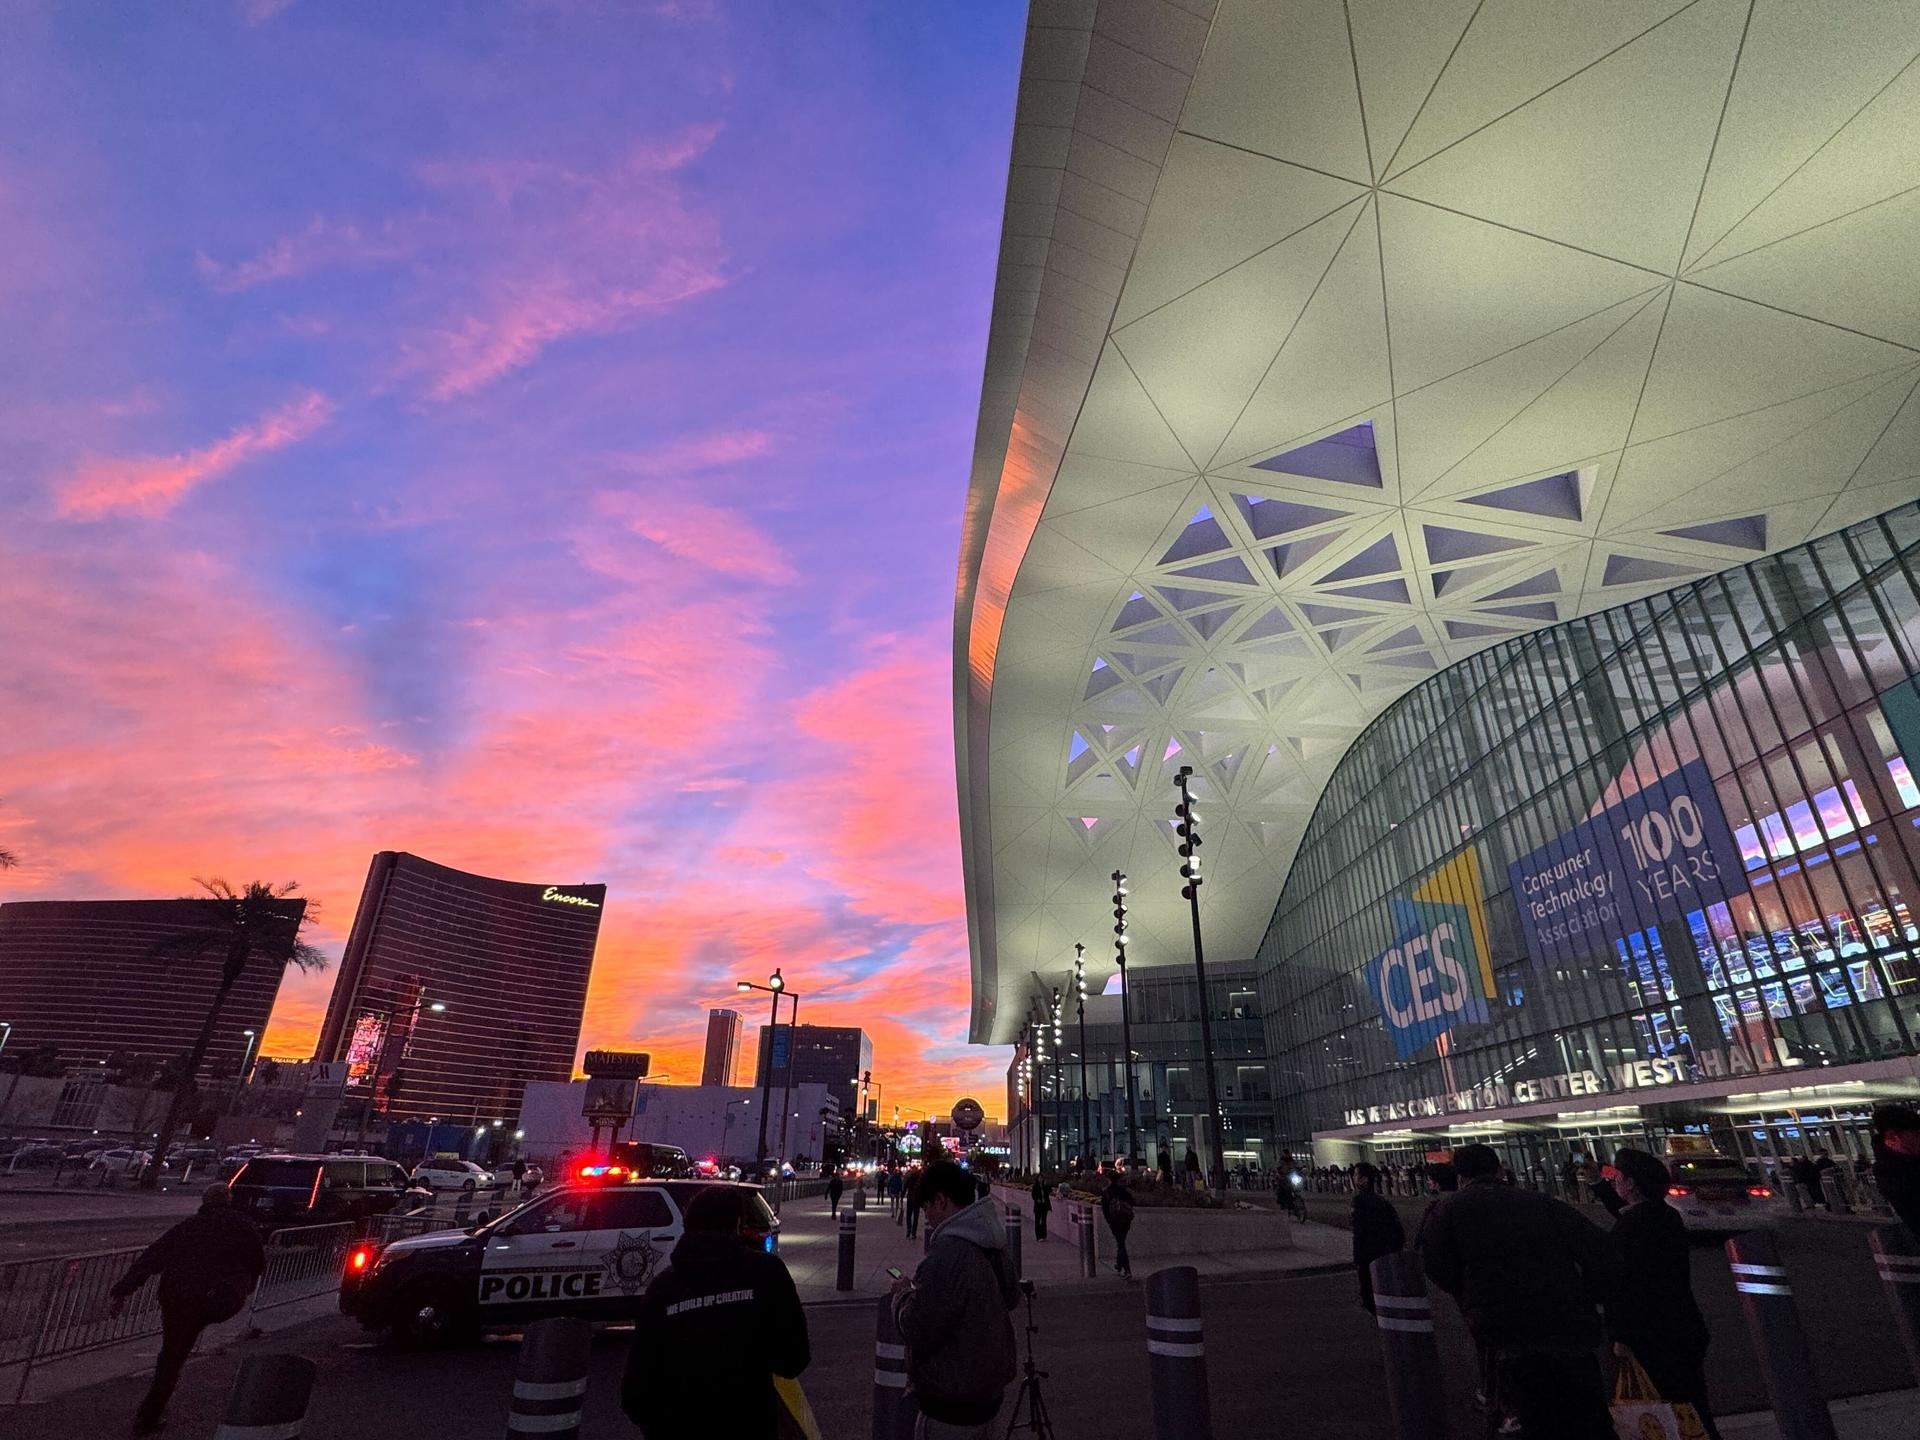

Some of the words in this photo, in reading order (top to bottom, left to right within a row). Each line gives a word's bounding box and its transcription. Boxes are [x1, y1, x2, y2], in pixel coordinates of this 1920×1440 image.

[1621, 795, 1704, 871] 100
[1522, 849, 1591, 894] Consumer
[1528, 871, 1613, 921] Technology
[1637, 850, 1721, 904] YEARS
[542, 886, 599, 908] Encore
[1380, 922, 1468, 1029] CES
[1344, 1109, 1366, 1126] LAS
[1366, 1102, 1407, 1123] VEGAS
[1408, 1084, 1512, 1117] CONVENTION
[1514, 1069, 1600, 1103] CENTER
[1607, 1054, 1688, 1091] WEST
[1698, 1037, 1805, 1077] HALL
[480, 1273, 602, 1300] POLICE
[703, 1295, 715, 1307] UP
[715, 1288, 755, 1305] CREATIVE
